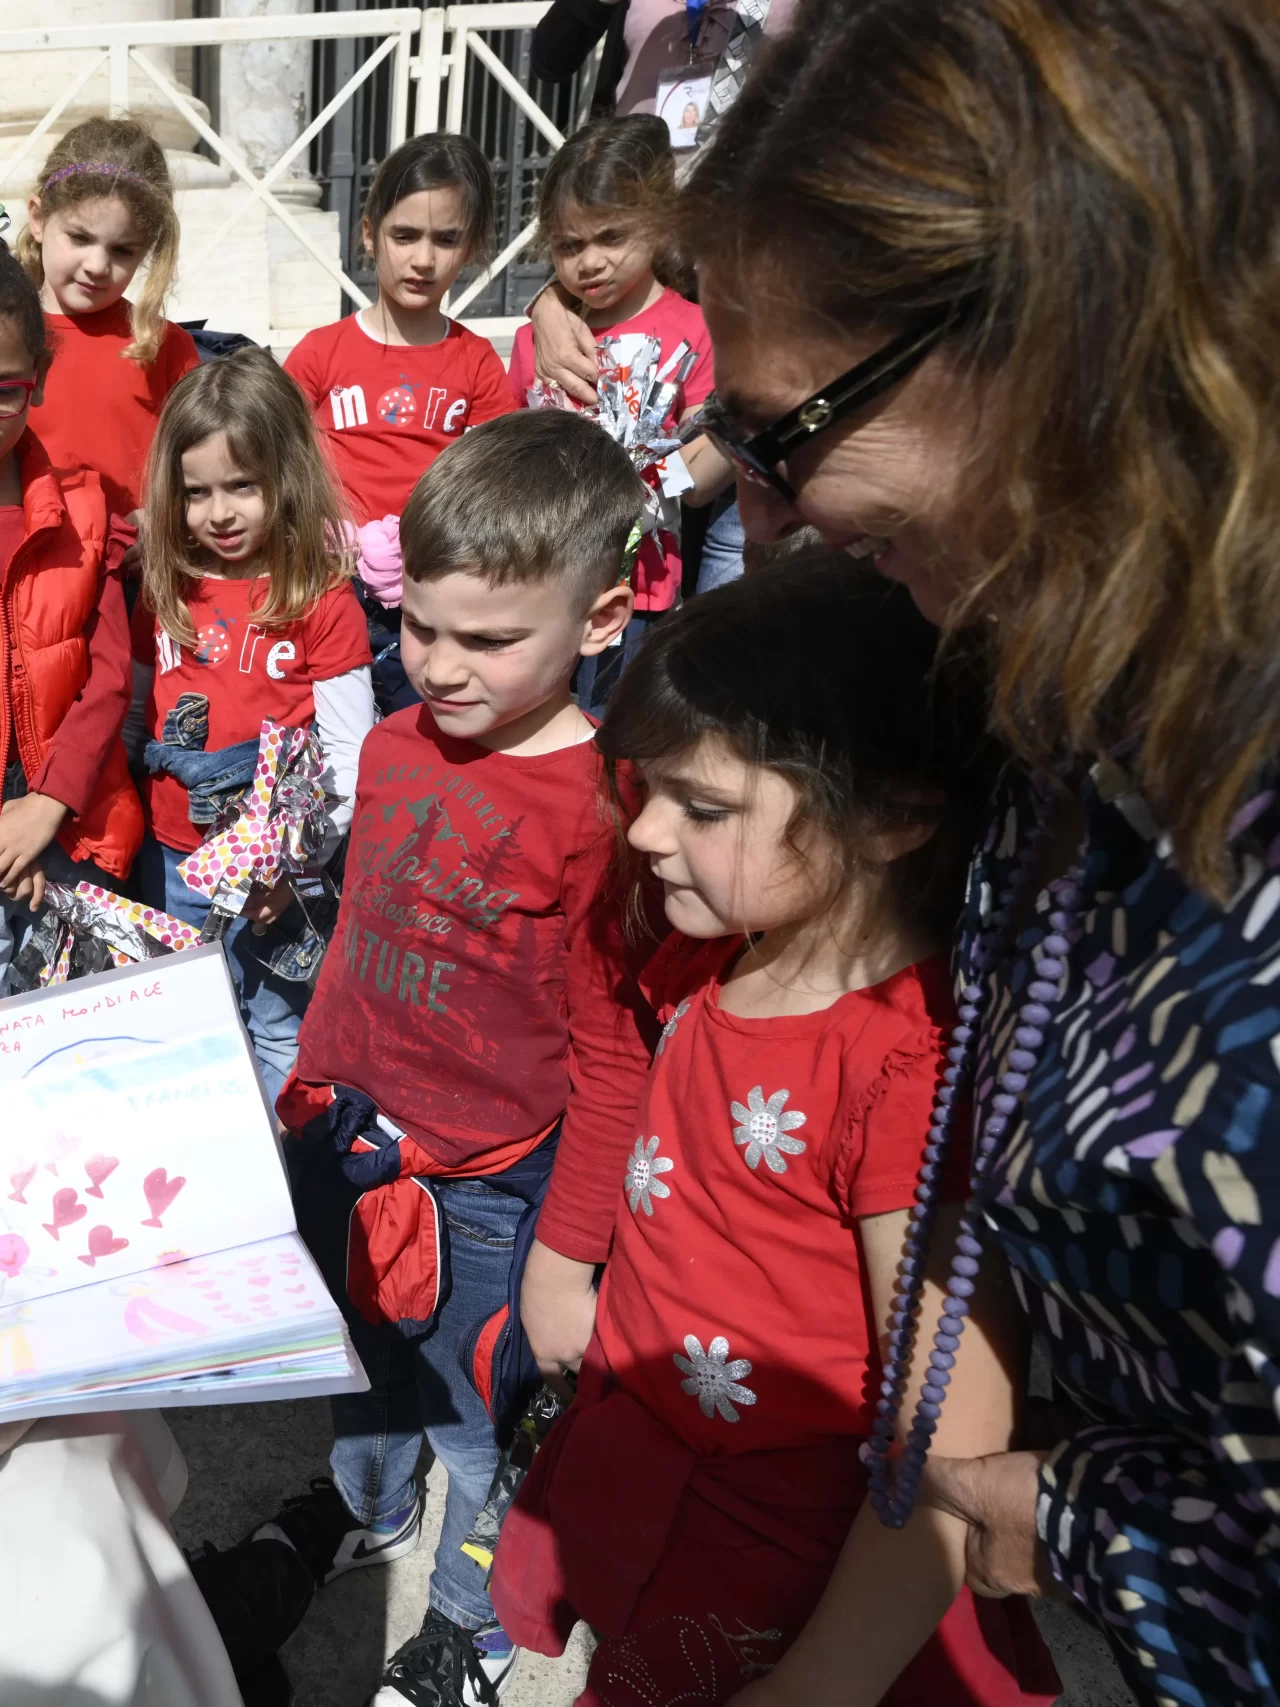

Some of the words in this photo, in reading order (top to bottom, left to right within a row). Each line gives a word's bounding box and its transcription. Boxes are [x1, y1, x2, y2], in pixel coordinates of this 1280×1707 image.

[376, 764, 432, 787] GREAT
[435, 769, 510, 841] JOURNEY
[367, 884, 455, 934] Respect
[62, 981, 163, 1020] MONDIALE
